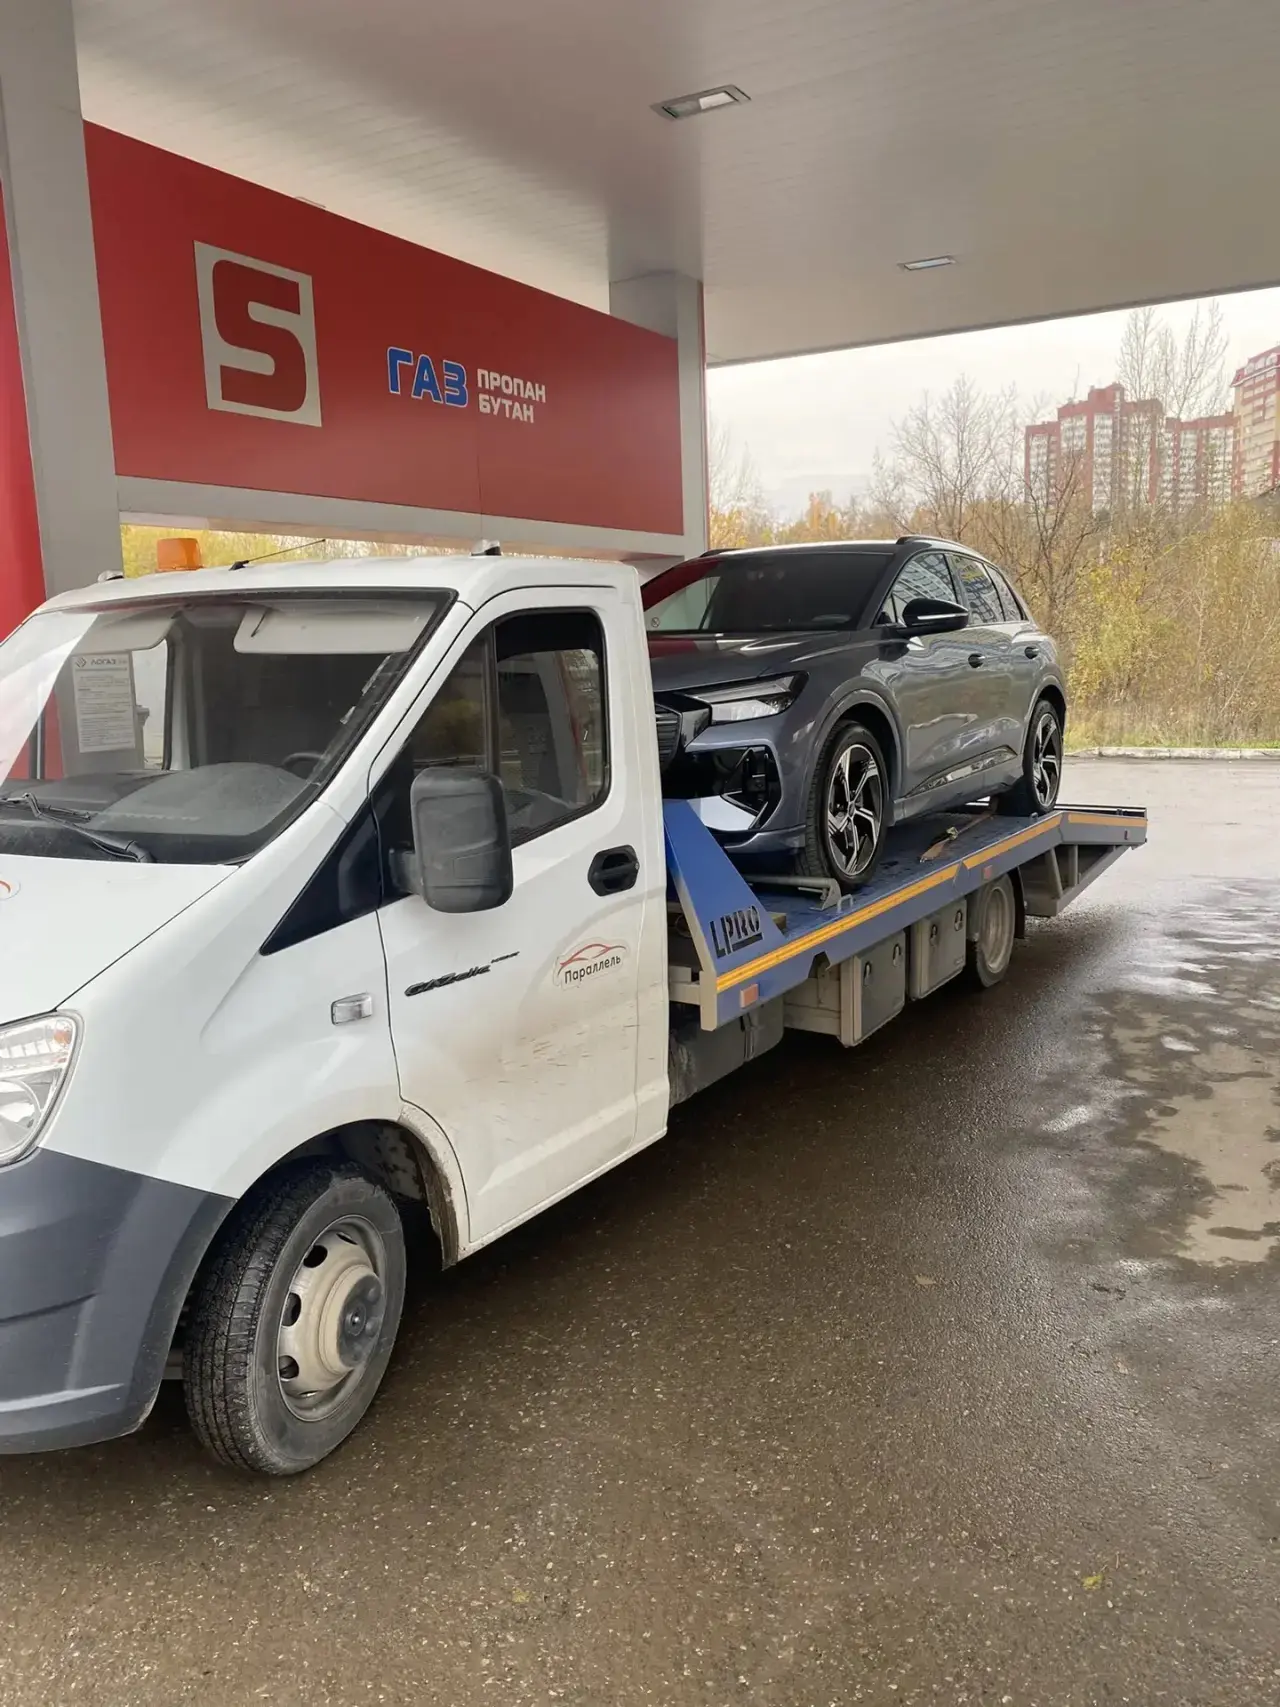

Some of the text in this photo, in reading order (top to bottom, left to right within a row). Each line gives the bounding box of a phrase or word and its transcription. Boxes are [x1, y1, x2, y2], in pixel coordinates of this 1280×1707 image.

[212, 259, 307, 412] S
[386, 346, 469, 408] ГАЗ
[477, 368, 546, 403] ПРОПАН
[479, 394, 534, 423] БУТАН
[564, 954, 622, 985] Параллель
